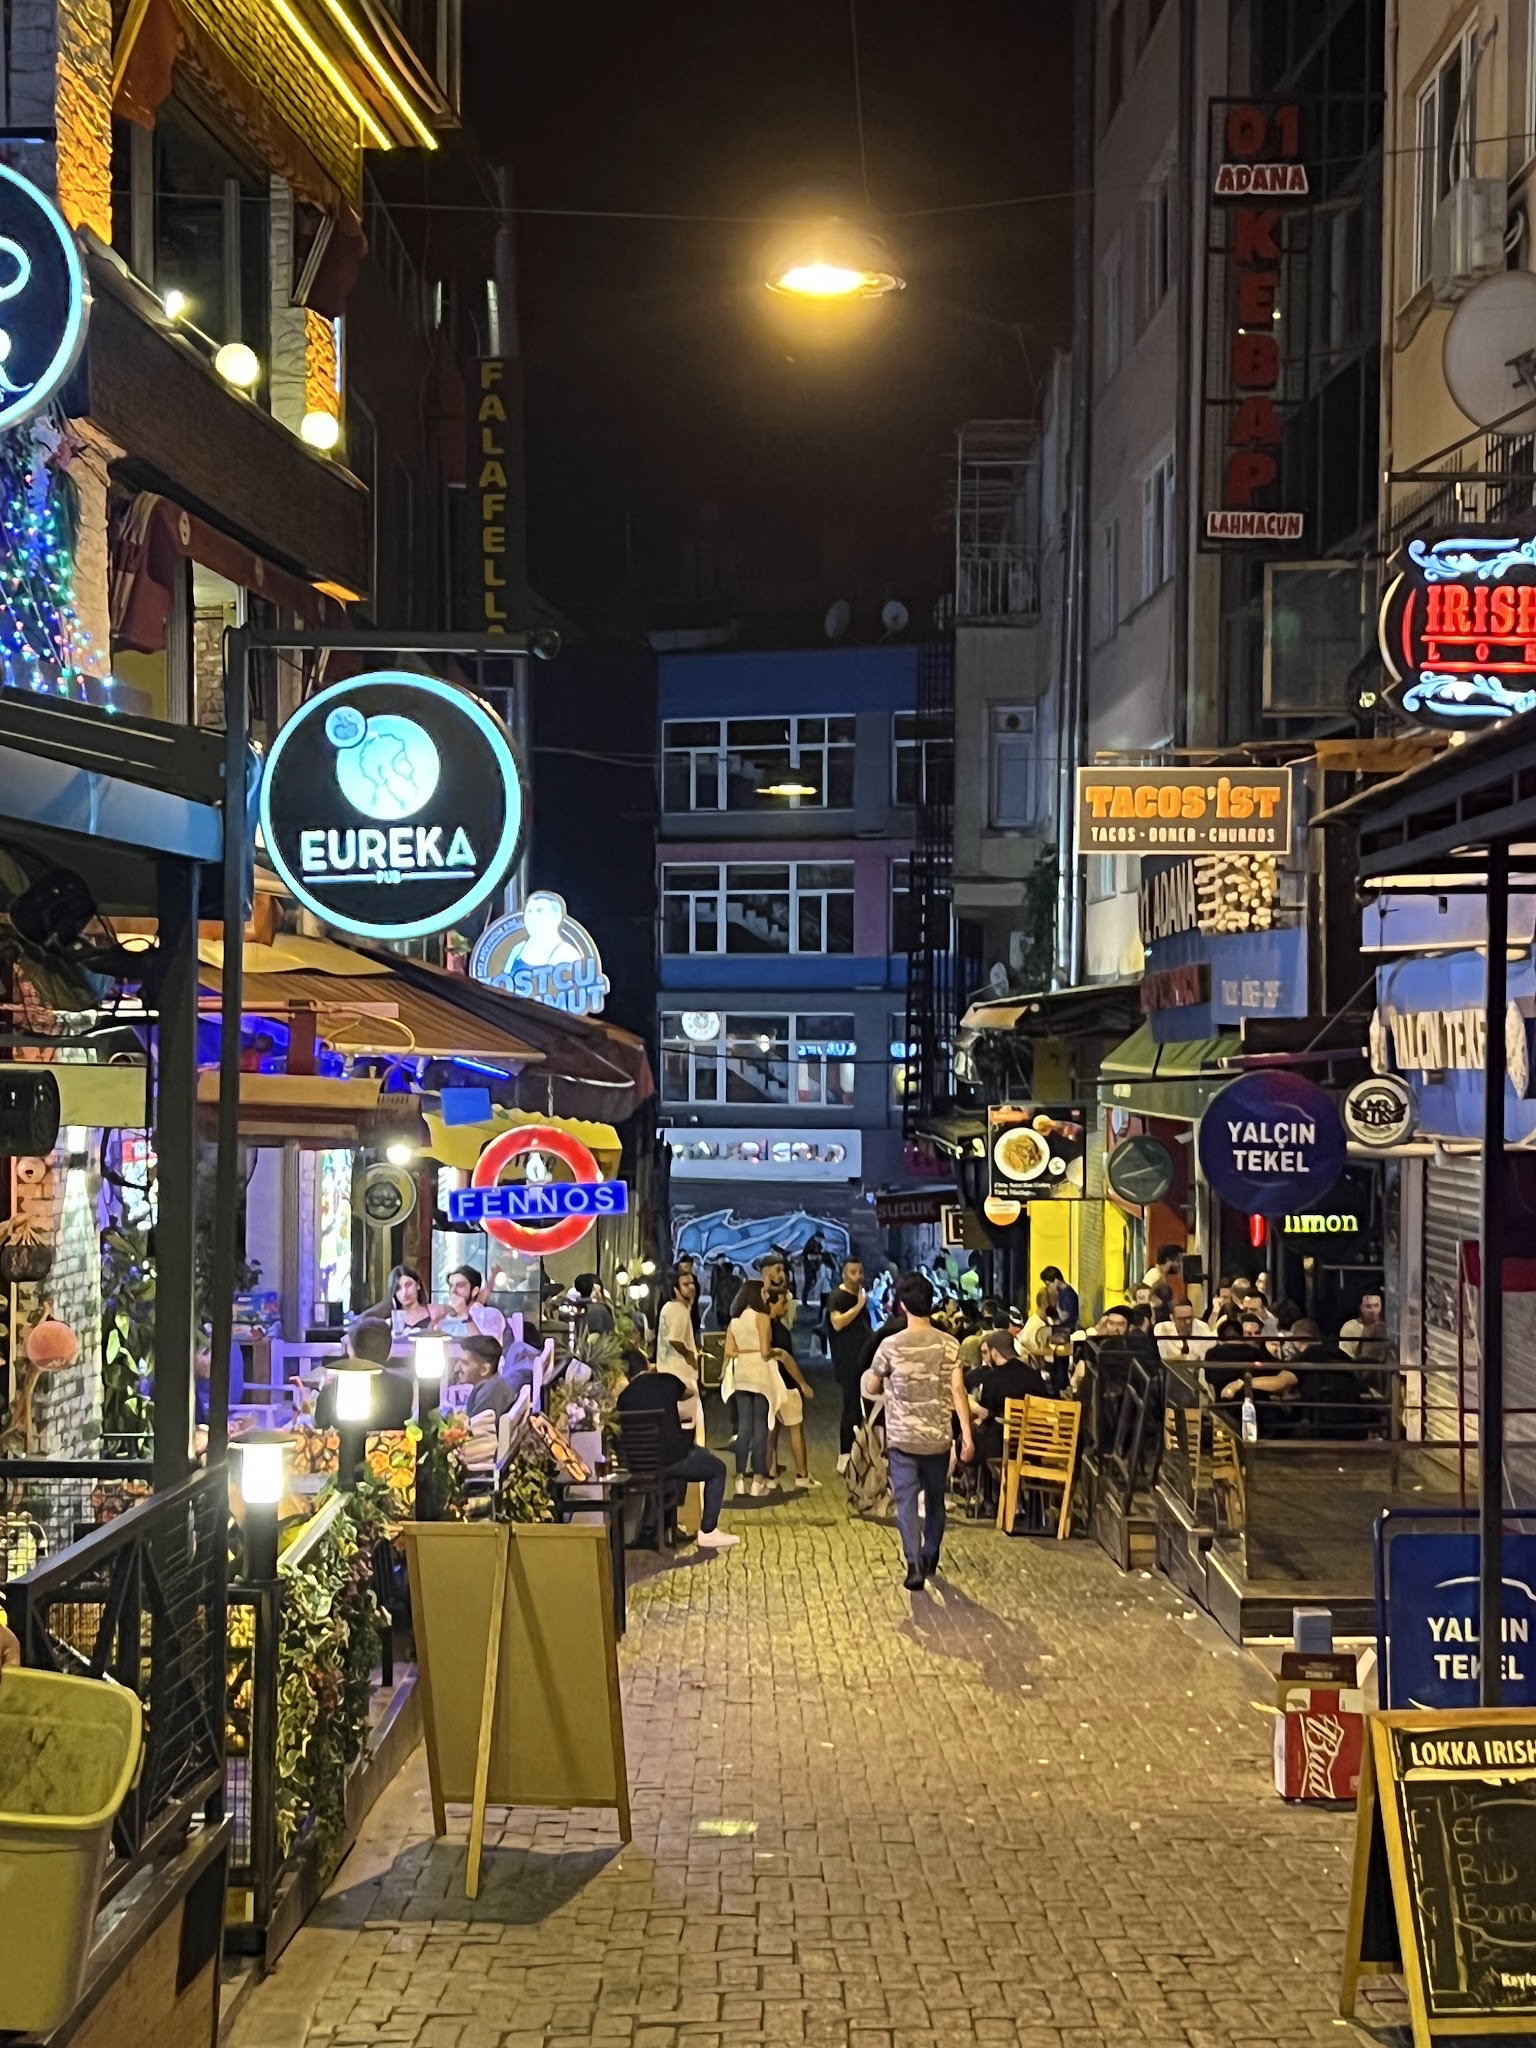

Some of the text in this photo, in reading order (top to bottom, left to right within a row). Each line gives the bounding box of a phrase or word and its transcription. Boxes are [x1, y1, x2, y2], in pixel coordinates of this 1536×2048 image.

[1215, 164, 1308, 194] ADANA
[1229, 207, 1280, 505] KEBAP
[478, 362, 508, 634] FALAFELL
[1209, 513, 1302, 537] LAHMACUN
[300, 826, 477, 871] EUREKA
[1091, 827, 1136, 842] TACOS
[1209, 828, 1275, 842] CHURROS
[1153, 858, 1197, 941] ADANA
[1227, 1121, 1316, 1149] YALÇIN
[1233, 1150, 1310, 1173] TEKEL
[458, 1187, 615, 1217] FENNOS
[1427, 1617, 1529, 1643] YALIN
[1305, 1713, 1345, 1799] Bud
[1410, 1740, 1481, 1766] LOKKA
